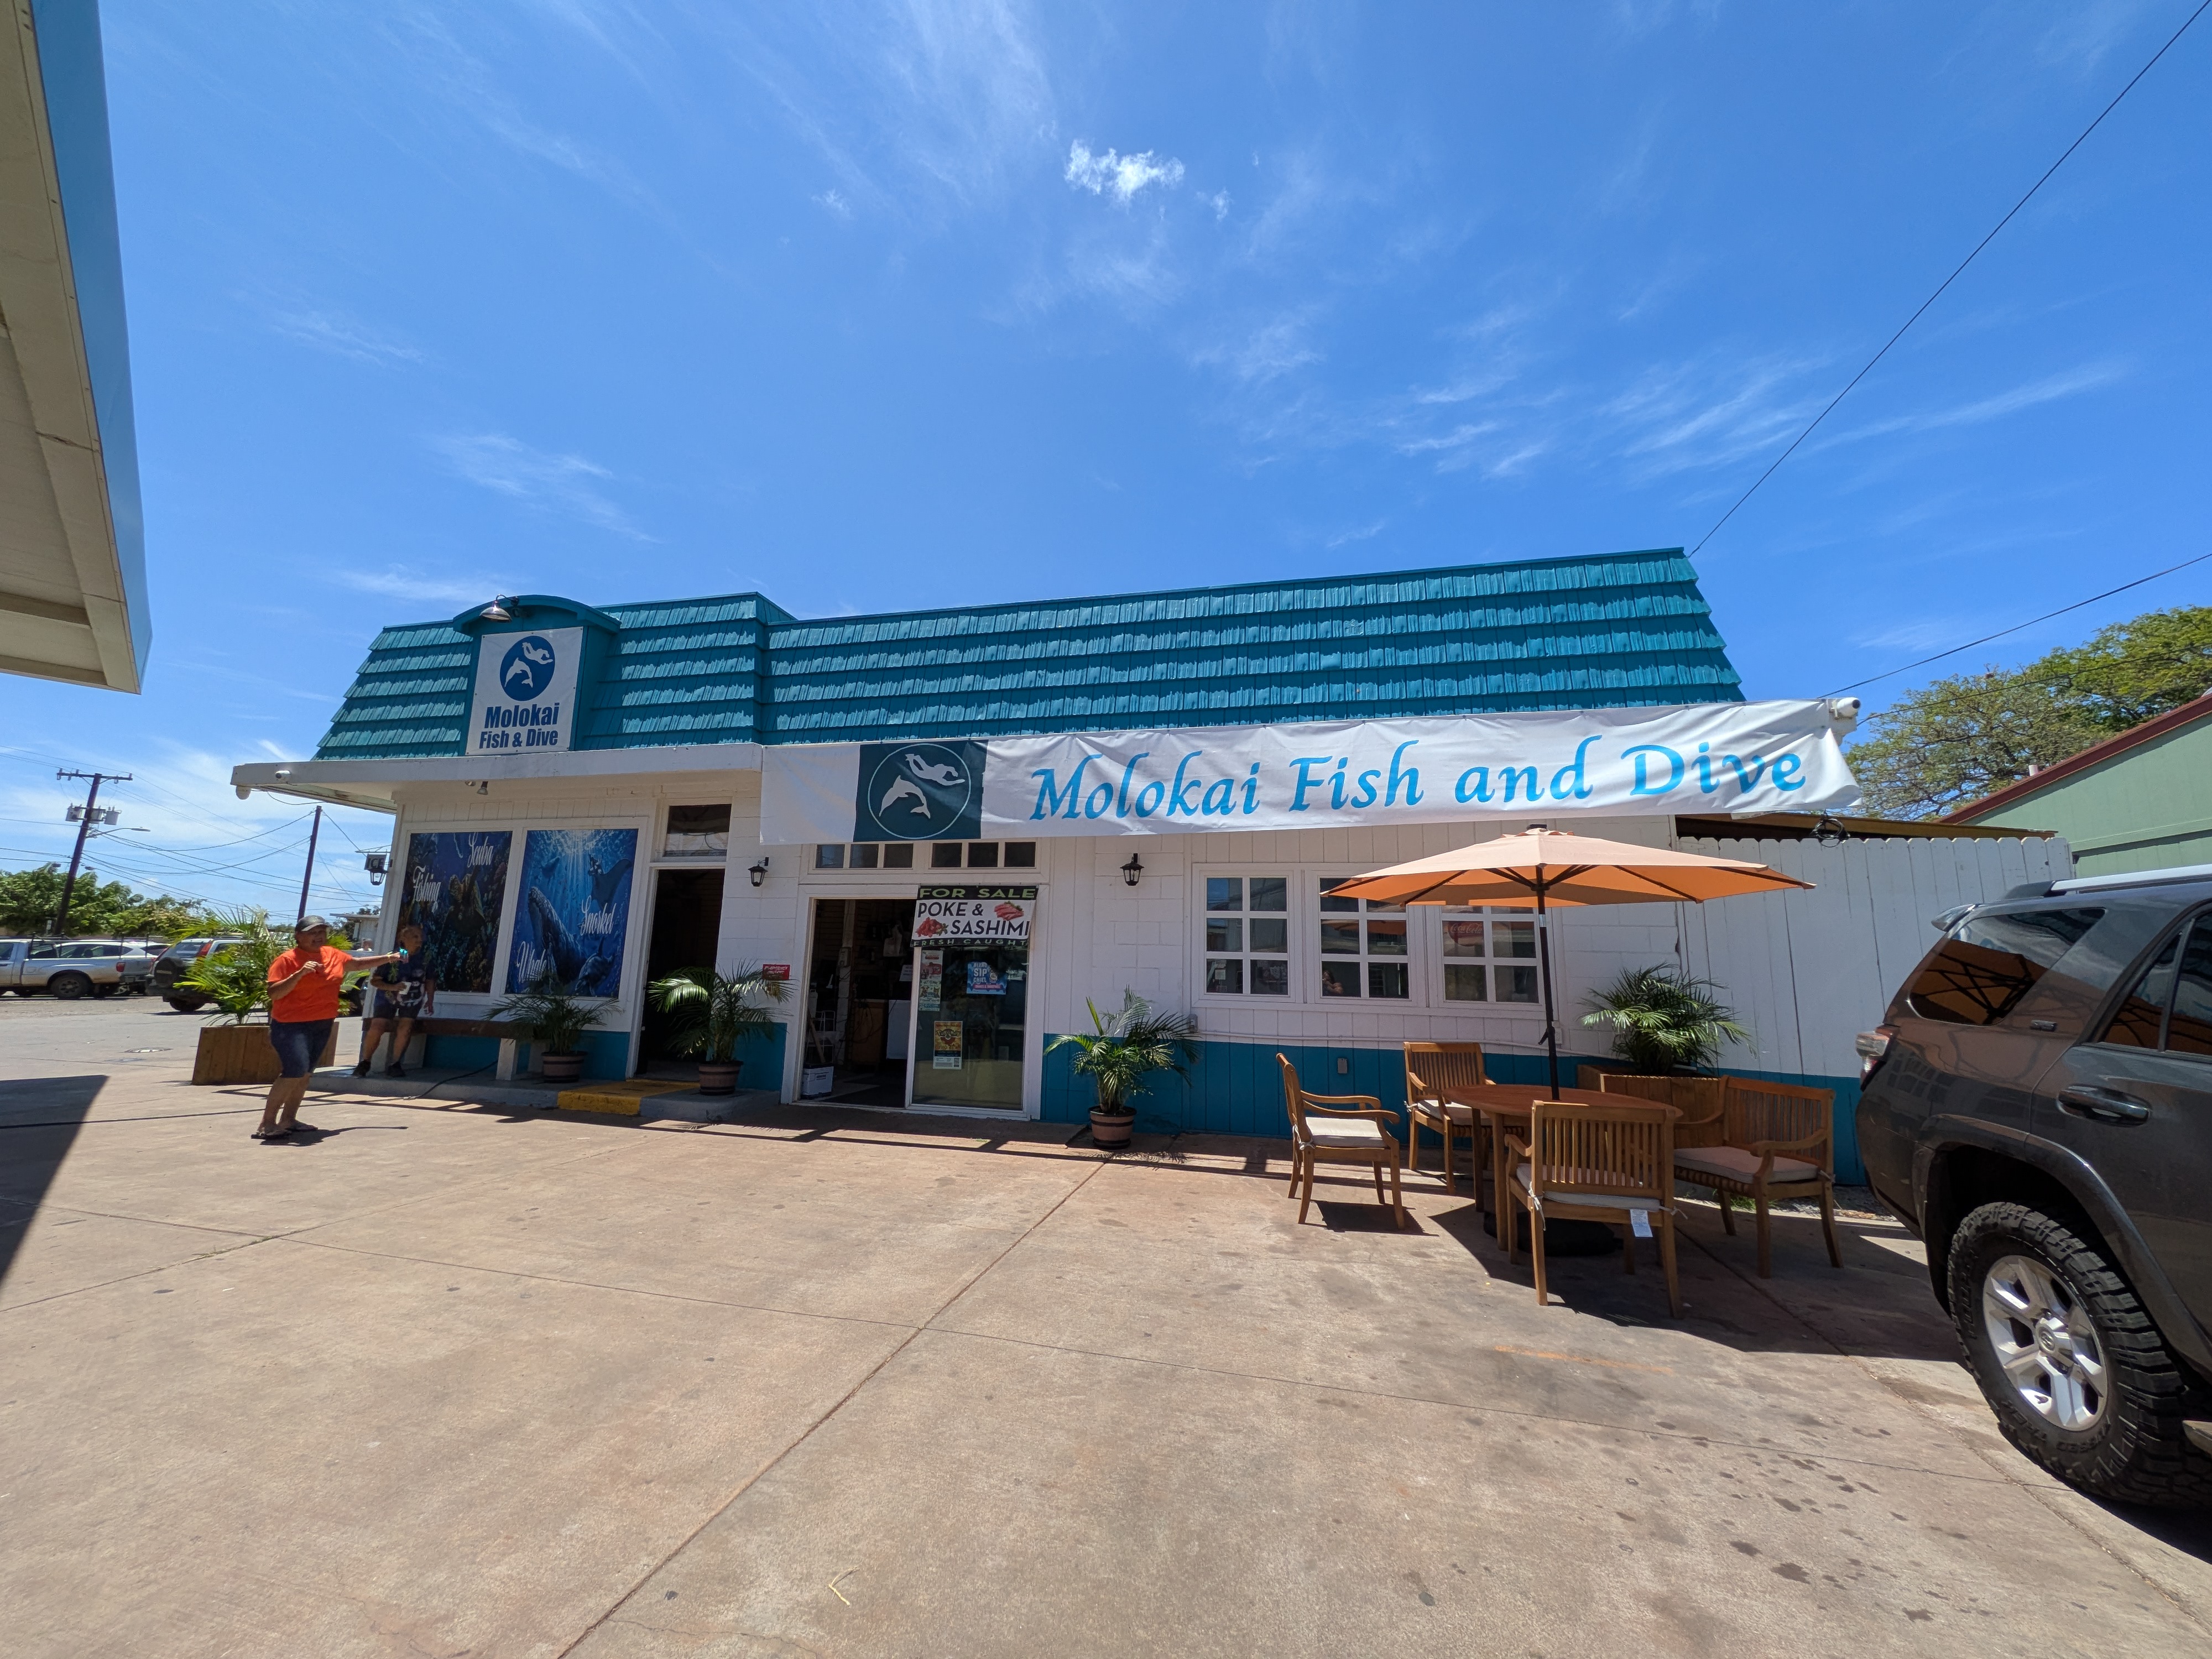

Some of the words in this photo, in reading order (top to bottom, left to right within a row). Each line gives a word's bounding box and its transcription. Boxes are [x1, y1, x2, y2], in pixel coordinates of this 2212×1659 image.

[484, 702, 560, 729] Molokai
[479, 731, 509, 749] Fish
[512, 732, 523, 747] &
[526, 728, 559, 747] Dive
[1029, 750, 1261, 820] Molokai
[1288, 740, 1425, 812] Fish
[1454, 735, 1603, 803] and
[1620, 742, 1806, 795] Dive
[467, 831, 494, 868] Scuba
[366, 858, 385, 869] ICE
[413, 865, 442, 914] Fishing
[919, 888, 966, 898] FOR
[977, 888, 1036, 898] SALE
[580, 895, 617, 936] Snorkel
[917, 901, 968, 918] POKE
[972, 903, 984, 916] &
[950, 920, 1030, 936] SASHIMI
[515, 941, 547, 984] Whale
[973, 968, 987, 977] SIP
